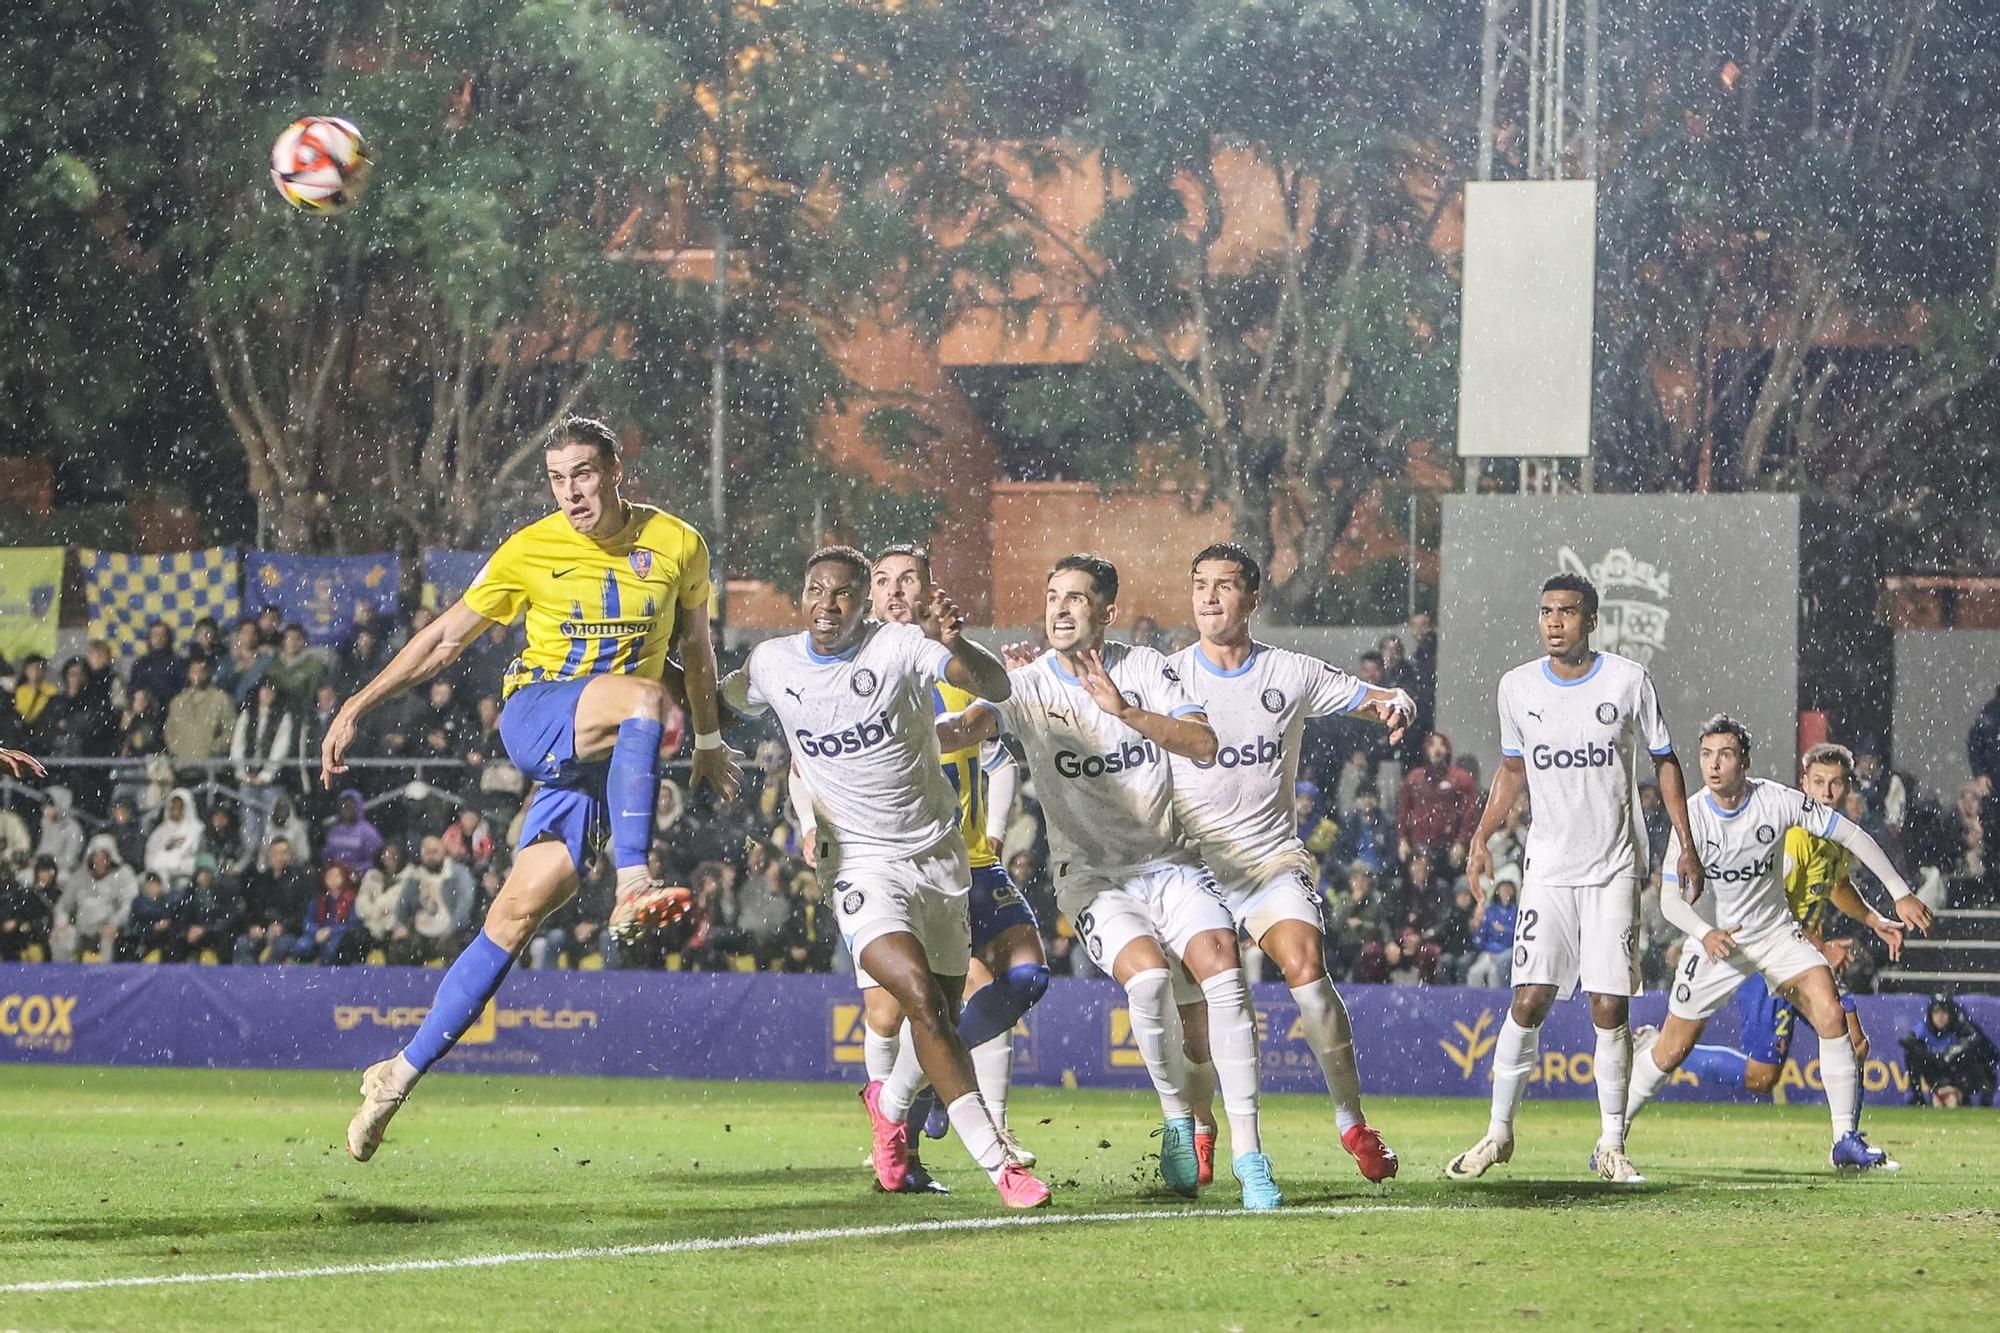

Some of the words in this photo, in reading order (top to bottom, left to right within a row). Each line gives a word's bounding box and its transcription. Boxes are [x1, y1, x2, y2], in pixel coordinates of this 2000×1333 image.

[796, 711, 895, 758] Gosbi
[1055, 734, 1155, 778] Gosbi
[1533, 740, 1614, 770] Gosbi
[1704, 853, 1775, 882] Gosbi
[1685, 954, 1699, 981] 4
[0, 993, 78, 1036] COX
[1776, 1009, 1791, 1036] 2
